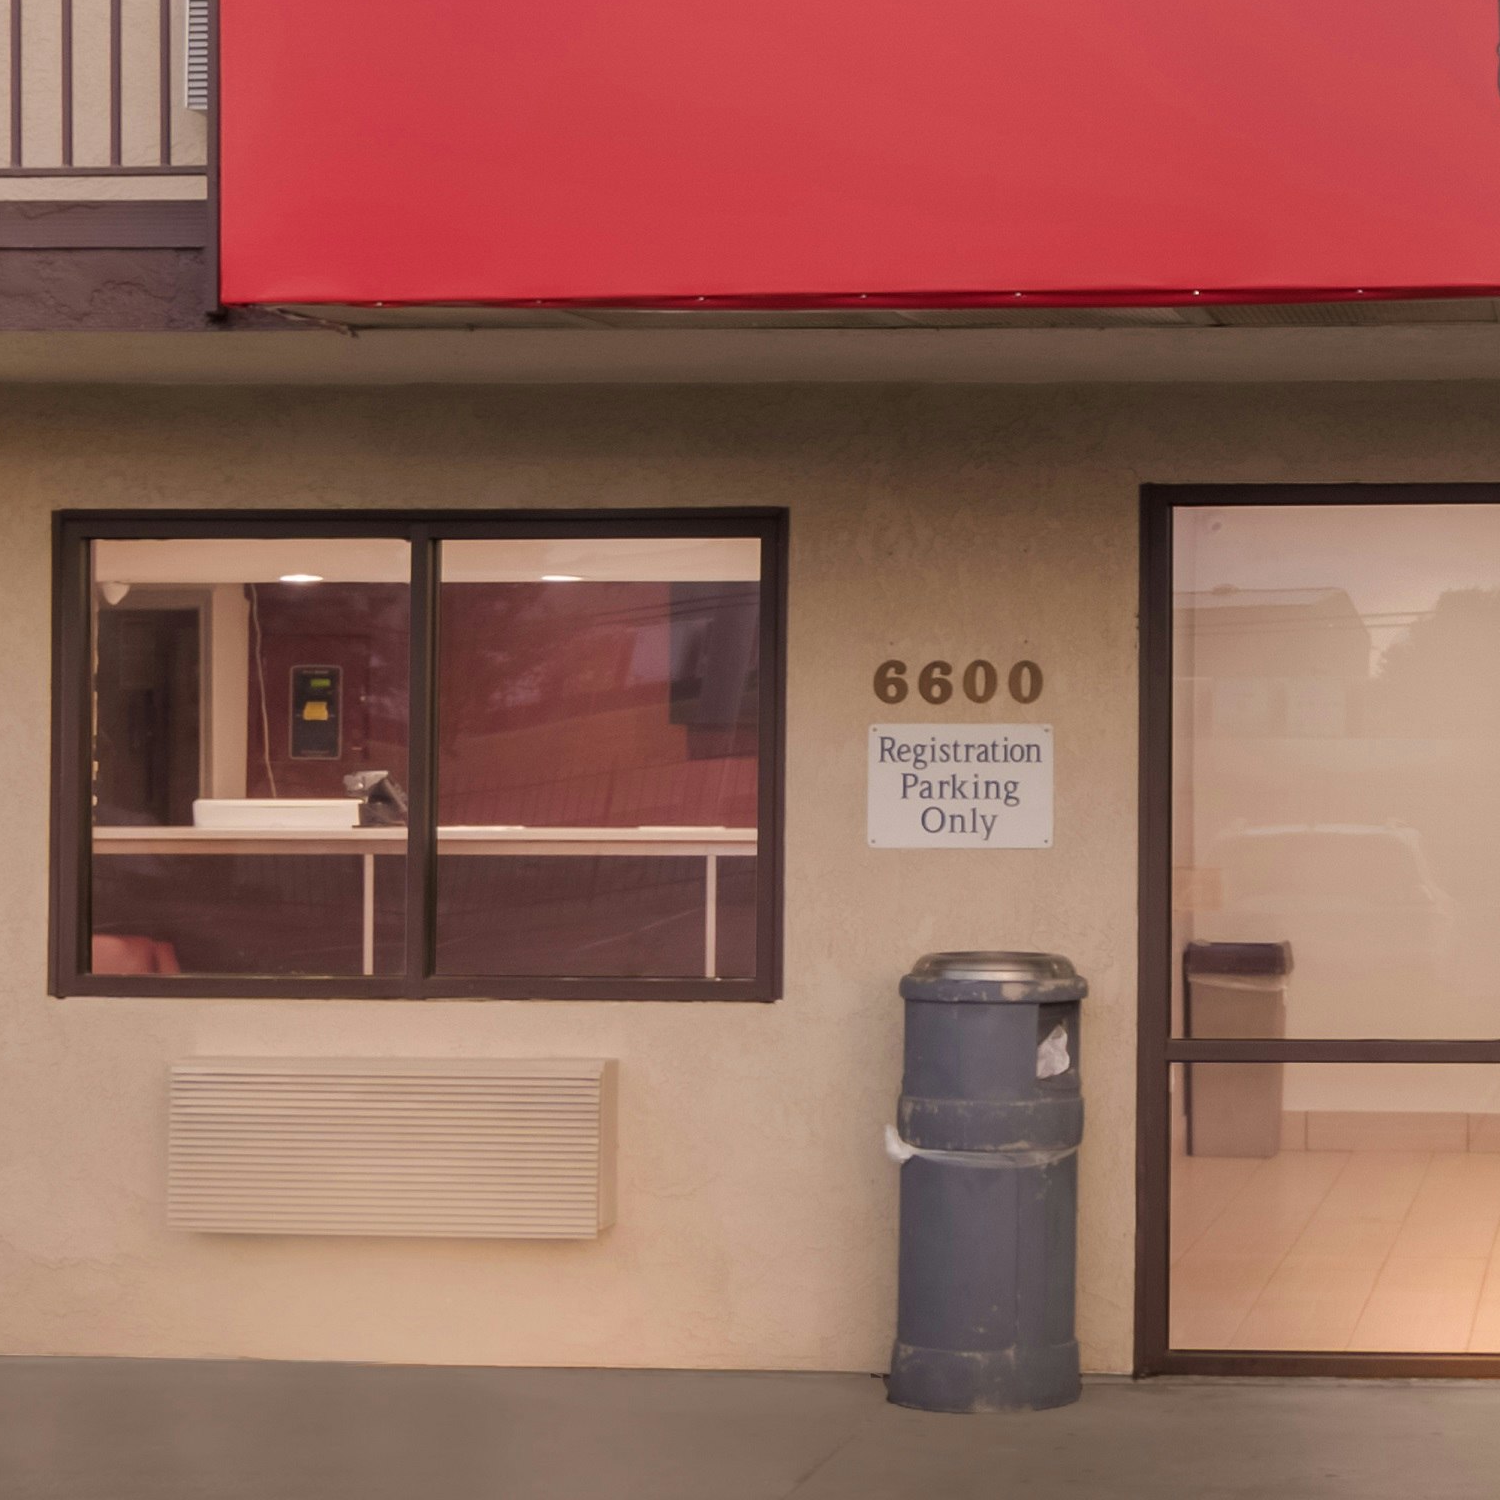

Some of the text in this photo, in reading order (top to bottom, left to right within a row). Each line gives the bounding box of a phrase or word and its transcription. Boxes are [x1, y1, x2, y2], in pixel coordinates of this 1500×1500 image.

[873, 659, 1044, 705] 6600
[878, 736, 1043, 770] Registration
[900, 772, 1021, 807] Parking
[920, 806, 998, 841] Only
